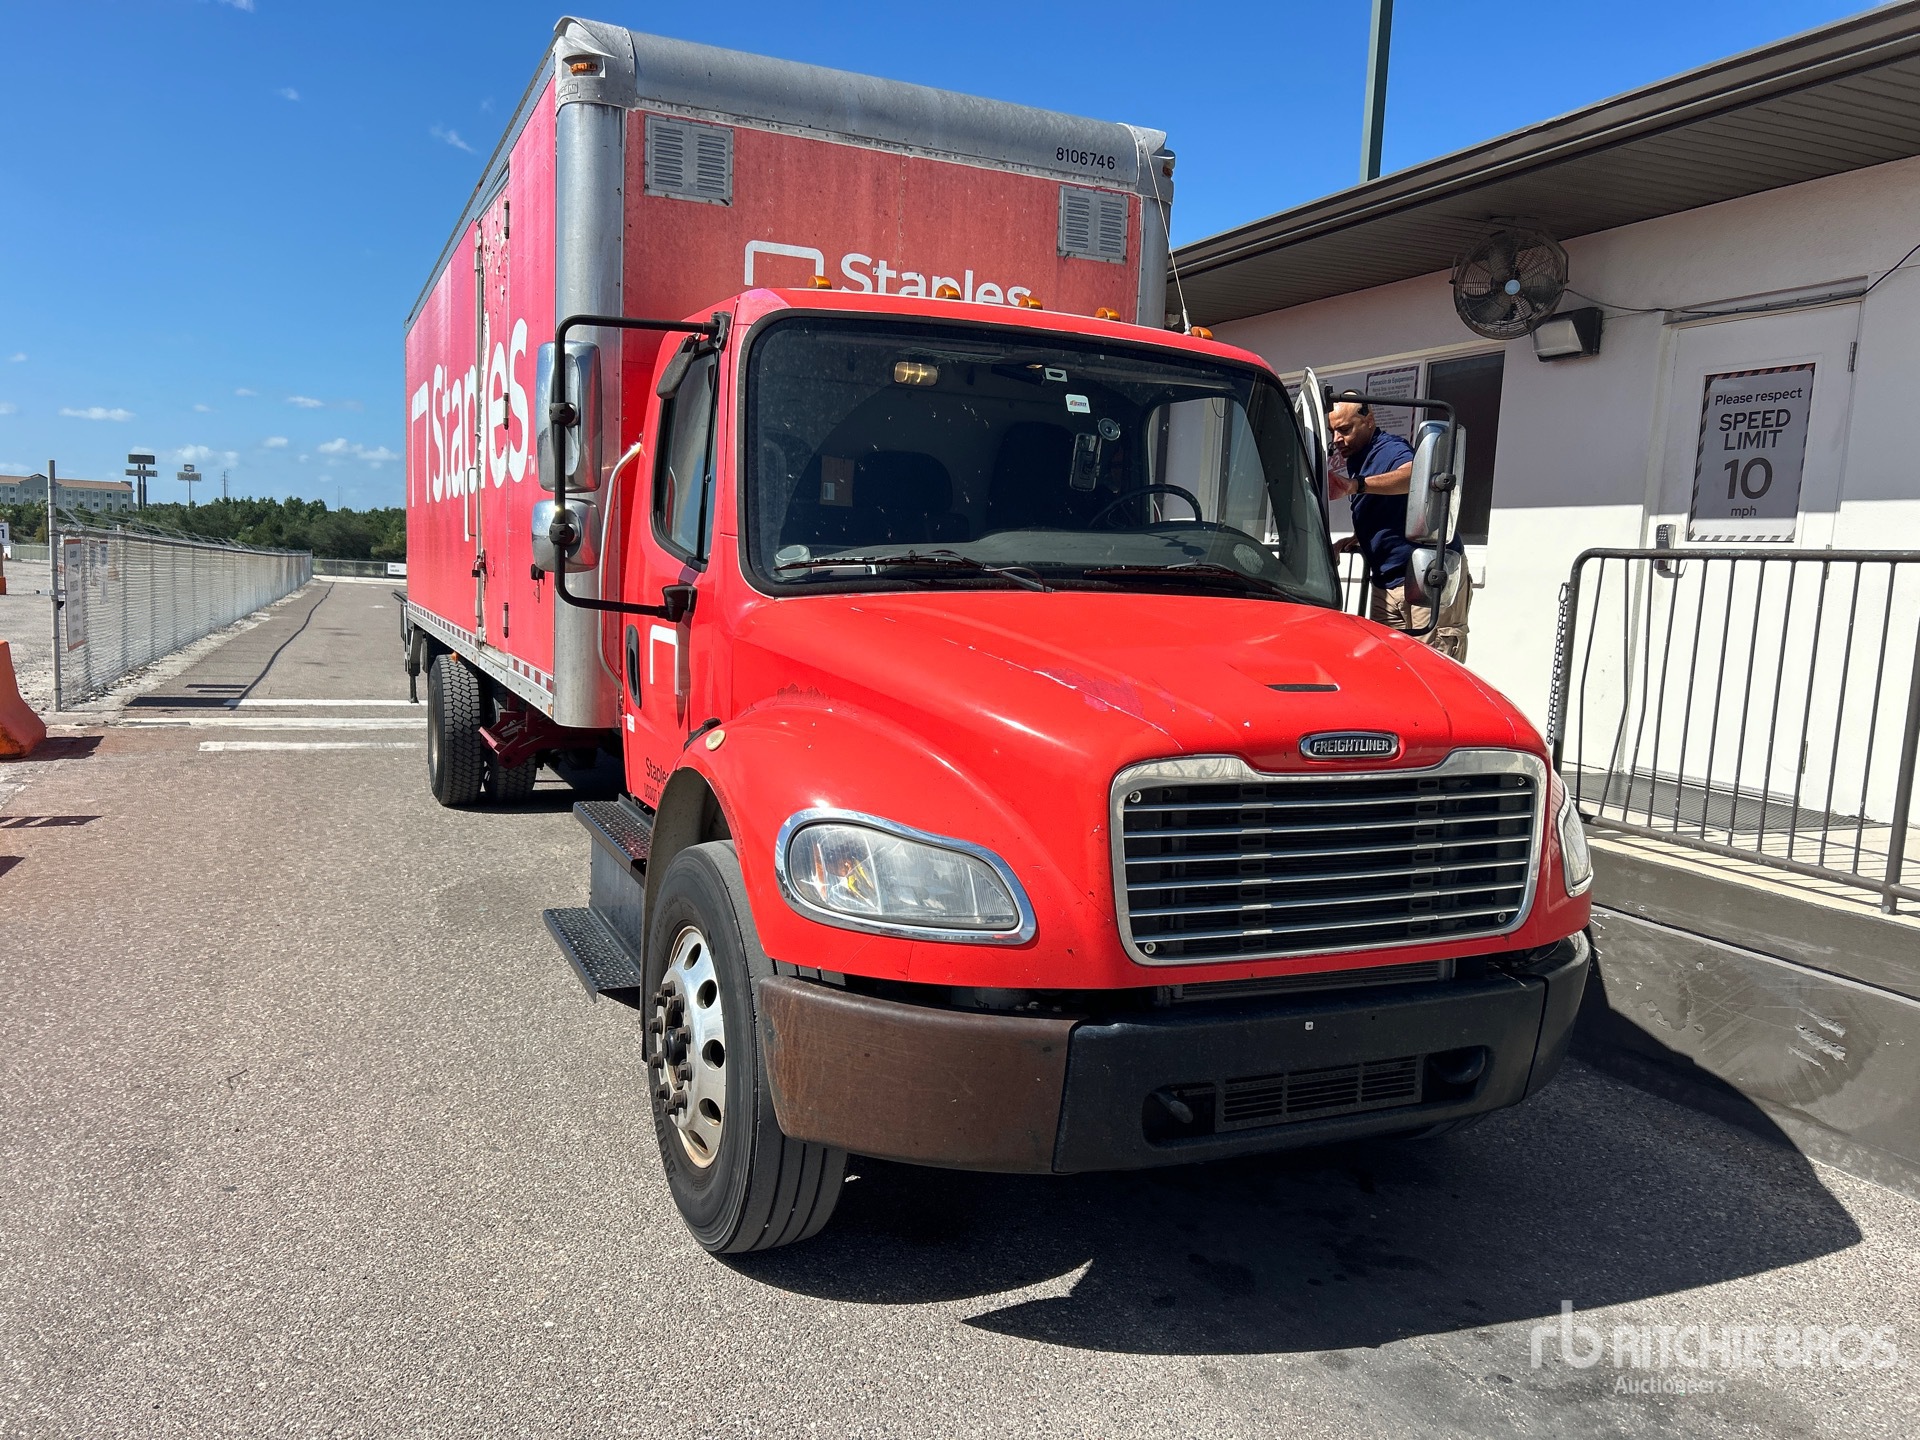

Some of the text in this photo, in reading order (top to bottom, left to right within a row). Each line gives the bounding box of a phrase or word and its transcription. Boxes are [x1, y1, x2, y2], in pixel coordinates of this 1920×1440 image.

[1056, 147, 1116, 170] 8106746
[1715, 387, 1803, 406] Please respect
[432, 311, 529, 542] Staples
[1719, 408, 1792, 432] SPEED
[1724, 429, 1783, 450] LIMIT
[1724, 457, 1773, 500] 10
[1730, 505, 1757, 519] mph
[1313, 739, 1389, 752] FREIGHTLINER
